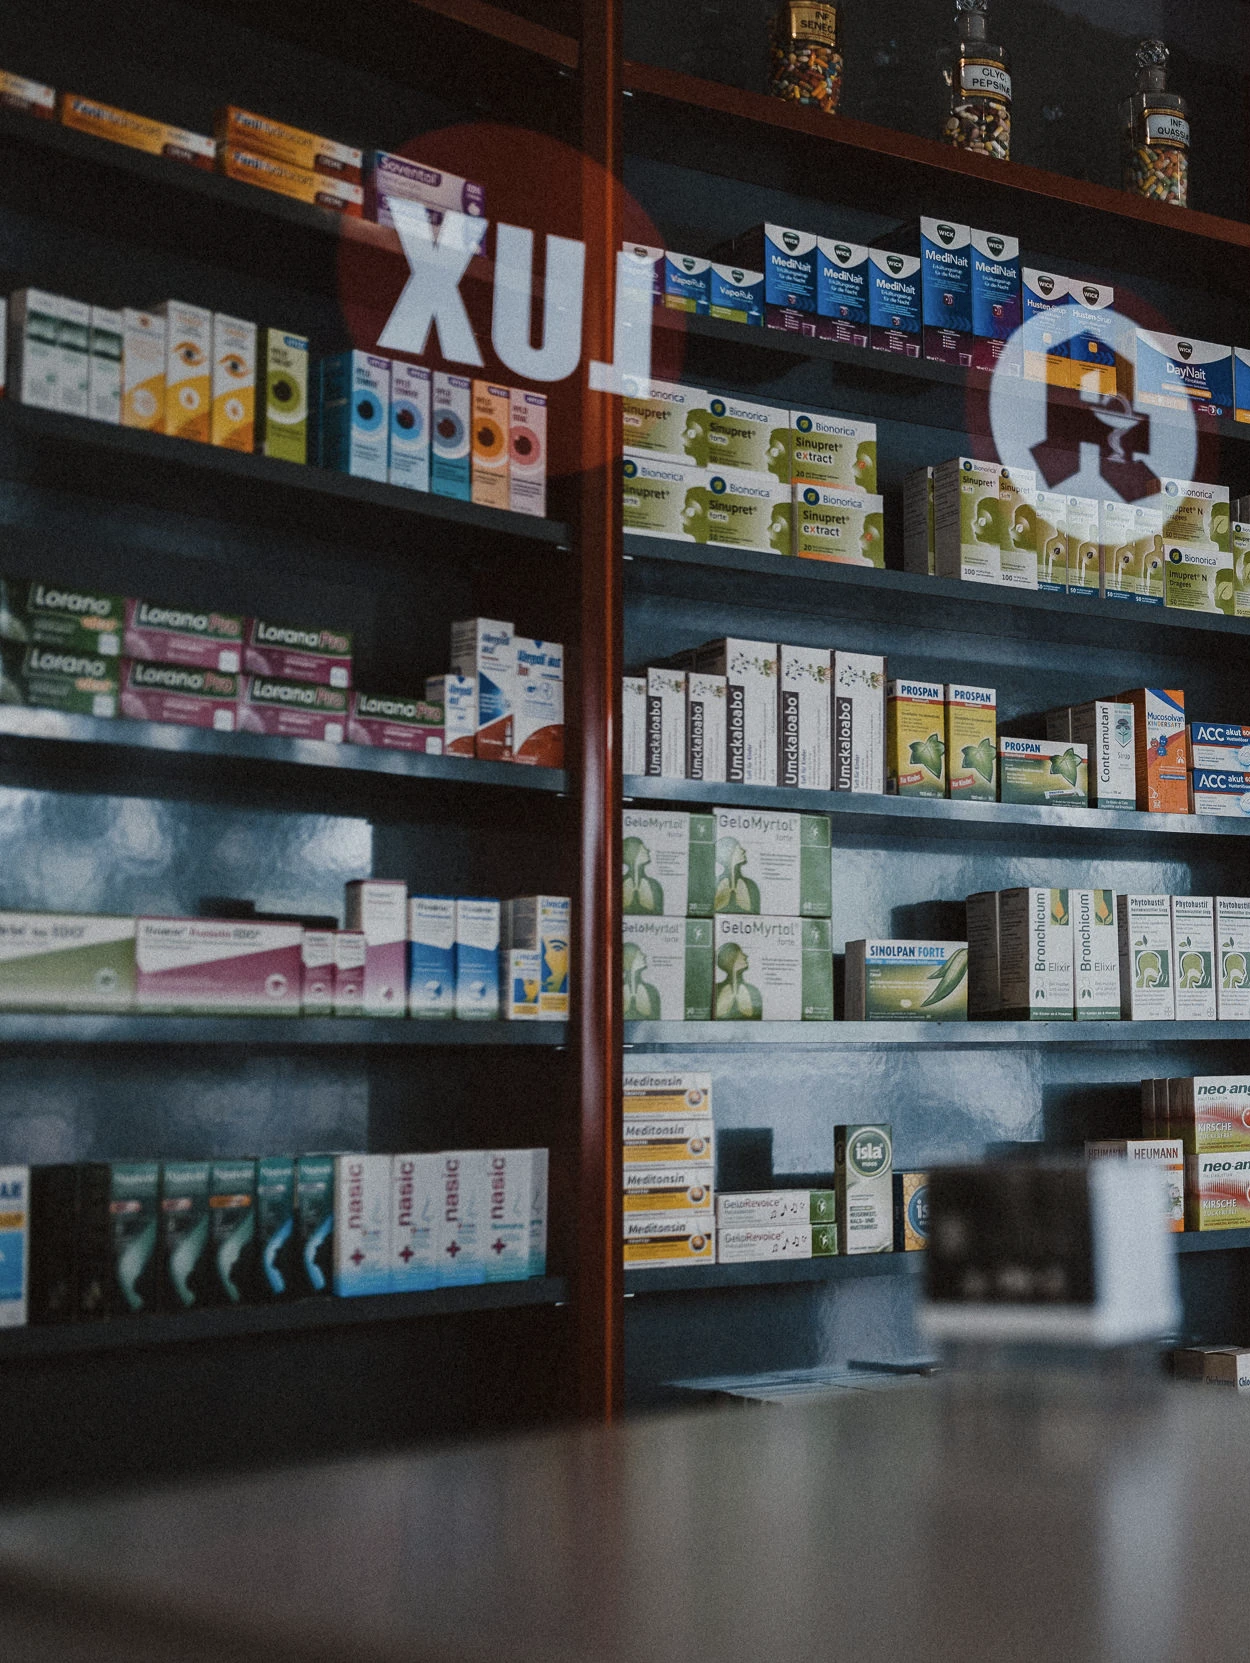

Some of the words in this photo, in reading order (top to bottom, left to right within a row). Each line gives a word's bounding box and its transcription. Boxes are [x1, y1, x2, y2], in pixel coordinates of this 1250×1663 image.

[938, 229, 955, 239] WICK
[835, 249, 851, 258] WICK
[987, 241, 1004, 251] WICK
[771, 255, 812, 274] MediNait
[888, 260, 903, 268] WICK
[925, 250, 968, 268] MediNait
[823, 267, 864, 285] MediNait
[975, 261, 1017, 280] MediNait
[670, 273, 706, 289] VapoRub
[876, 278, 916, 296] MediNait
[1038, 280, 1053, 290] WICK
[719, 285, 754, 301] VapoRub
[1083, 291, 1099, 300] WICK
[1178, 346, 1193, 355] WICK
[1166, 362, 1206, 381] DayNait
[729, 406, 768, 423] Bionorica
[709, 422, 752, 440] Sinupret
[815, 422, 856, 437] Bionorica
[795, 437, 839, 453] Sinupret
[795, 451, 833, 465] extract
[641, 467, 685, 482] Bionorica
[962, 475, 994, 489] Sinupret
[729, 483, 771, 498] Bionorica
[709, 500, 753, 516] Sinupret
[823, 495, 863, 510] Bionorica
[803, 510, 846, 525] Sinupret
[803, 524, 840, 538] extract
[1184, 553, 1217, 567] Bionorica
[964, 568, 976, 576] 100
[1001, 573, 1013, 582] 100
[1169, 570, 1197, 582] Imupret
[1201, 574, 1208, 582] N
[1170, 580, 1191, 588] Dragees
[35, 585, 111, 616] Lorano
[140, 603, 208, 630] Lorano
[258, 622, 319, 647] Lorano
[30, 649, 106, 678] Lorano
[136, 663, 203, 689] Lorano
[253, 678, 315, 704] Lorano
[901, 684, 939, 698] PROSPAN
[954, 689, 991, 703] PROSPAN
[360, 695, 416, 718] Lorano
[1147, 711, 1185, 723] Mucosolvan
[1147, 720, 1182, 729] KINDERSAFT
[650, 698, 662, 775] Umckaloabo
[692, 703, 704, 779] Umckaloabo
[729, 690, 744, 781] Umckaloabo
[785, 696, 798, 786] Umckaloabo
[1197, 727, 1224, 742] ACC
[1225, 728, 1241, 737] akut
[838, 702, 852, 790] Umckaloabo
[1005, 741, 1041, 753] PROSPAN
[1100, 706, 1111, 782] Contramutan
[1199, 774, 1226, 789] ACC
[1228, 775, 1244, 783] akut
[625, 816, 683, 830] GeloMyrtol
[719, 814, 794, 832] GeloMyrtol
[1131, 898, 1164, 908] Phytohustil
[1175, 900, 1208, 909] Phytohustil
[1219, 901, 1250, 910] Phytohustil
[721, 920, 795, 938] GeloMyrtol
[1034, 893, 1046, 972] Bronchicum
[1079, 893, 1092, 972] Bronchicum
[870, 945, 916, 957] SINOLPAN
[918, 946, 945, 958] FORTE
[1048, 961, 1070, 972] Elixir
[1094, 961, 1116, 972] Elixir
[624, 1076, 683, 1087] Meditonsin
[626, 1125, 685, 1137] Meditonsin
[1198, 1123, 1232, 1134] KIRSCHE
[856, 1142, 883, 1160] isla
[1134, 1147, 1178, 1159] HEUMANN
[627, 1174, 685, 1186] Meditonsin
[346, 1162, 364, 1229] nasic
[395, 1161, 414, 1227] nasic
[442, 1158, 460, 1223] nasic
[487, 1157, 505, 1220] nasic
[723, 1197, 780, 1209] GeloRevoice
[1203, 1199, 1237, 1210] KIRSCHE
[628, 1223, 686, 1235] Meditonsin
[725, 1233, 783, 1244] GeloRevoice
